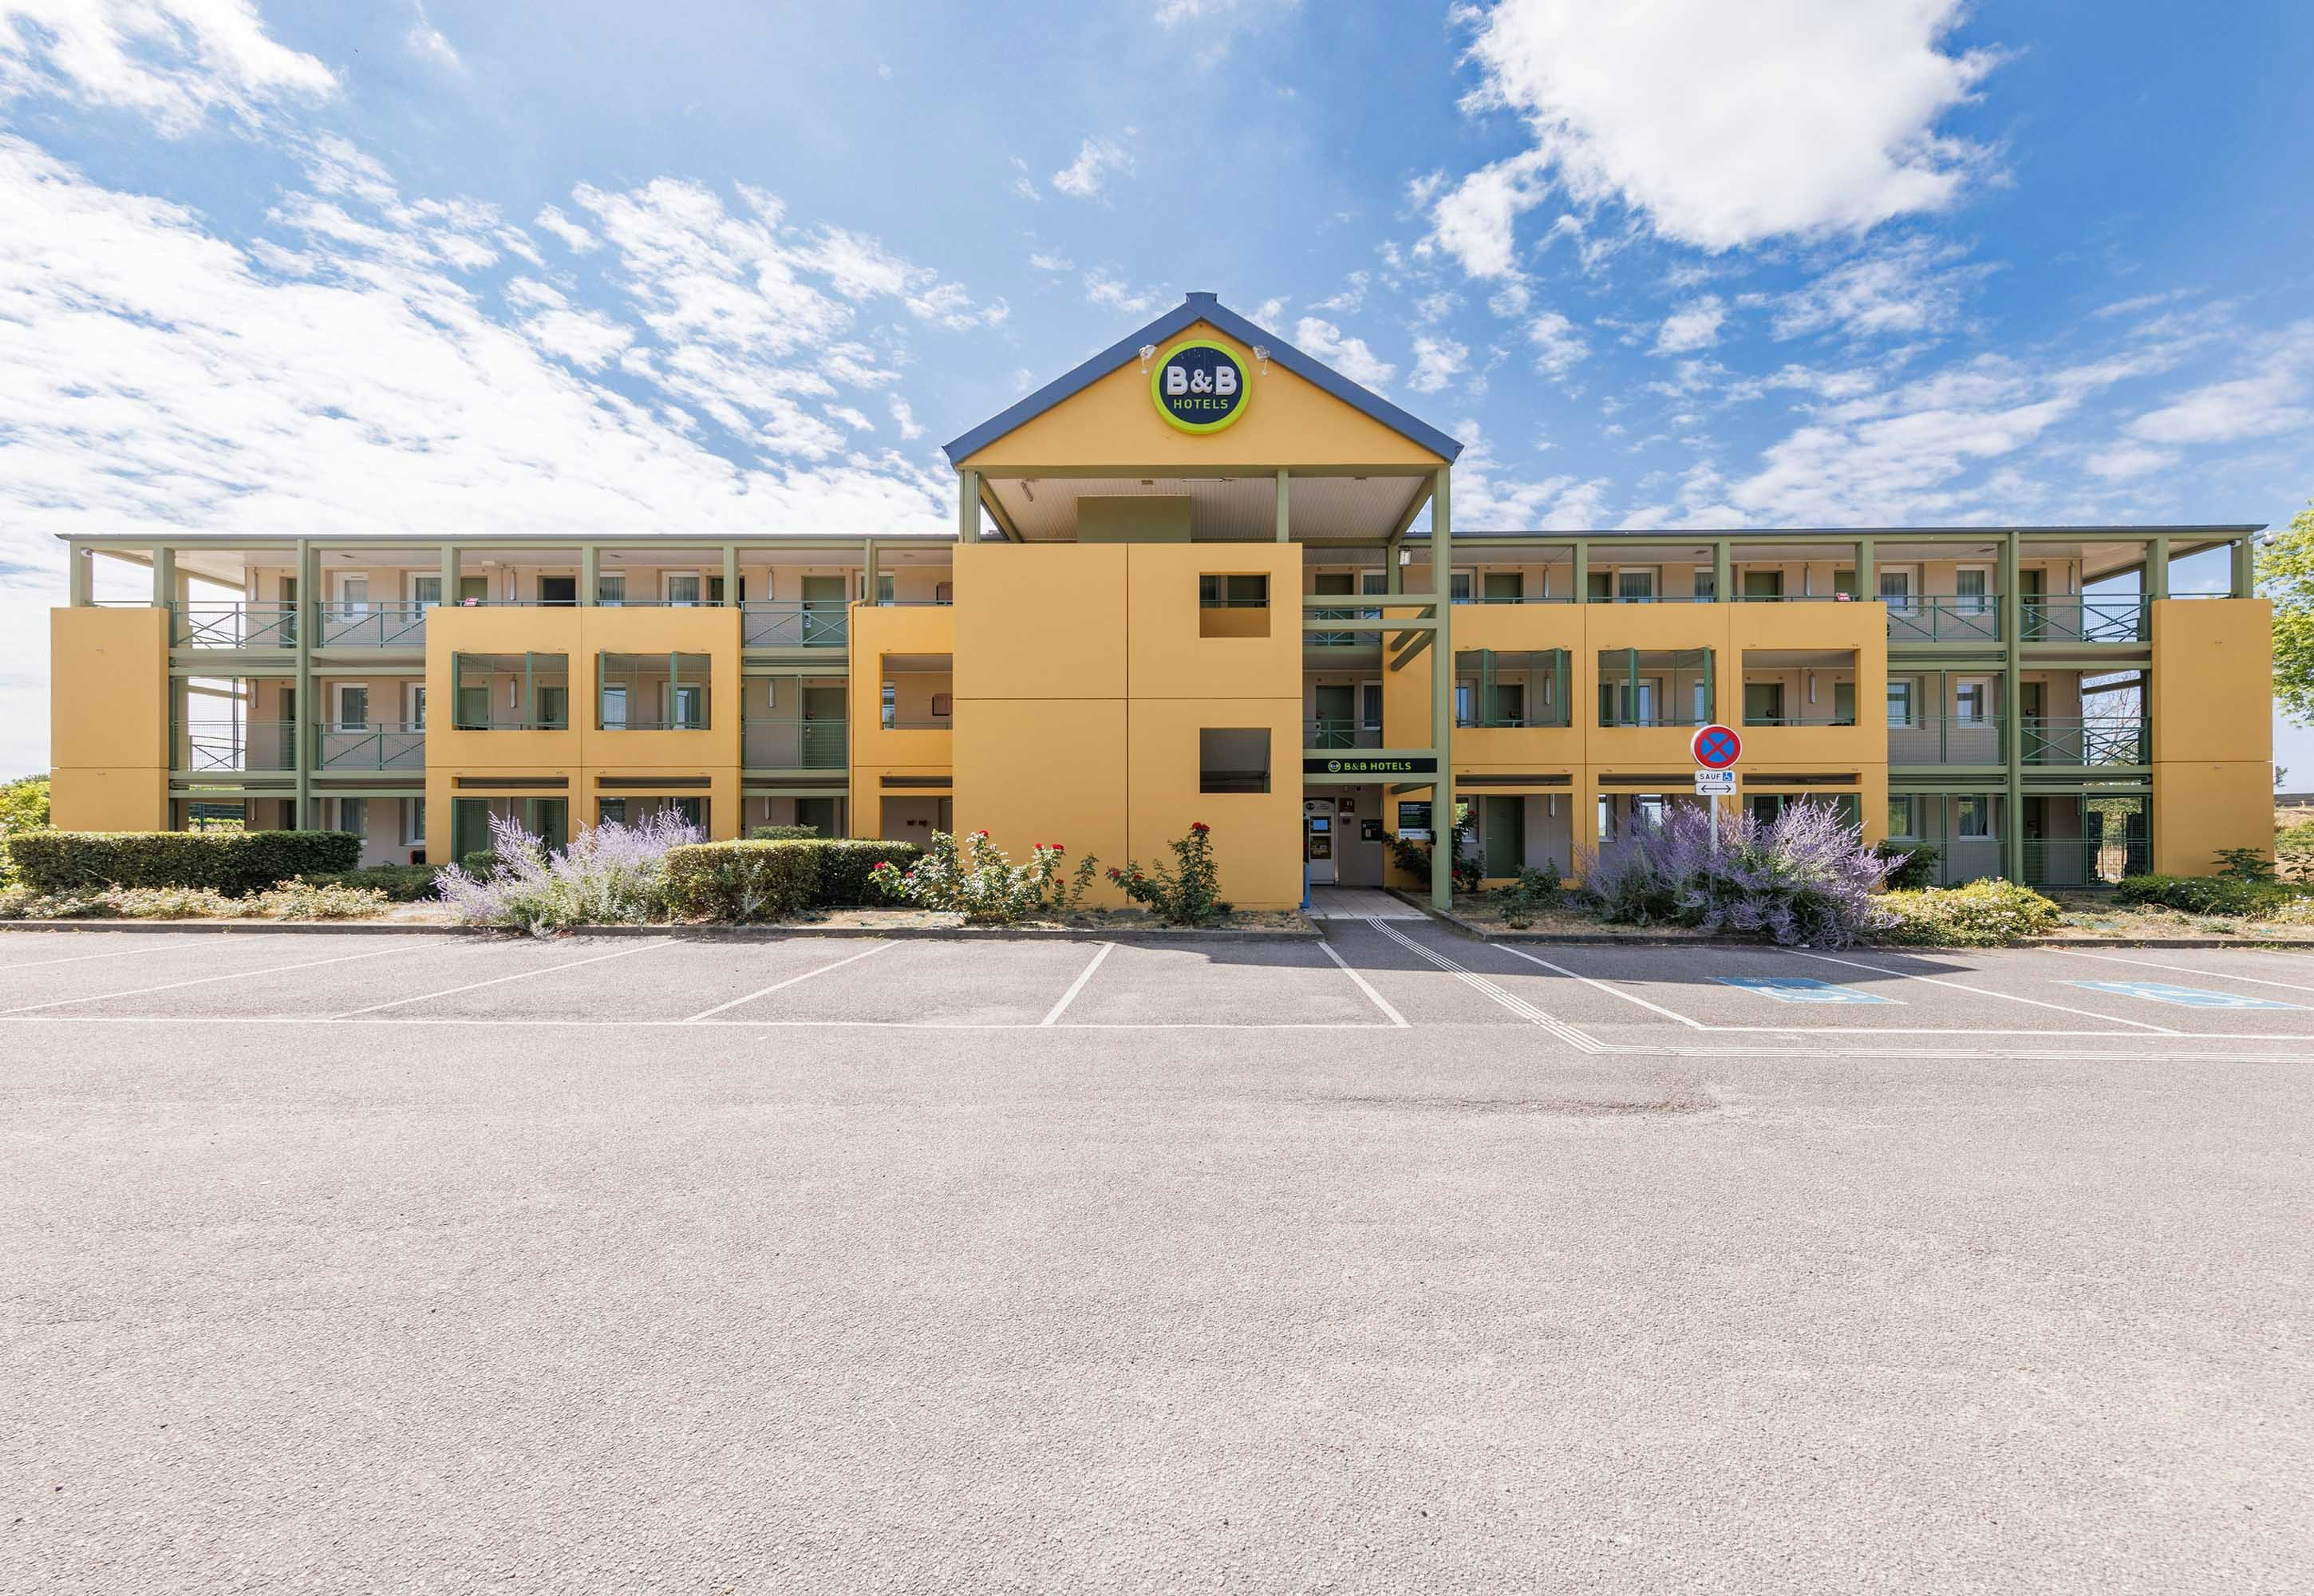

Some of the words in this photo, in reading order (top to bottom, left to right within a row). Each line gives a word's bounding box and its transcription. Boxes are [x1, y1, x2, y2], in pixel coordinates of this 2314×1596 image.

[1167, 366, 1237, 395] B&B
[1174, 399, 1229, 409] HOTELS
[1344, 762, 1367, 771] B&B
[1370, 762, 1412, 771] HOTELS
